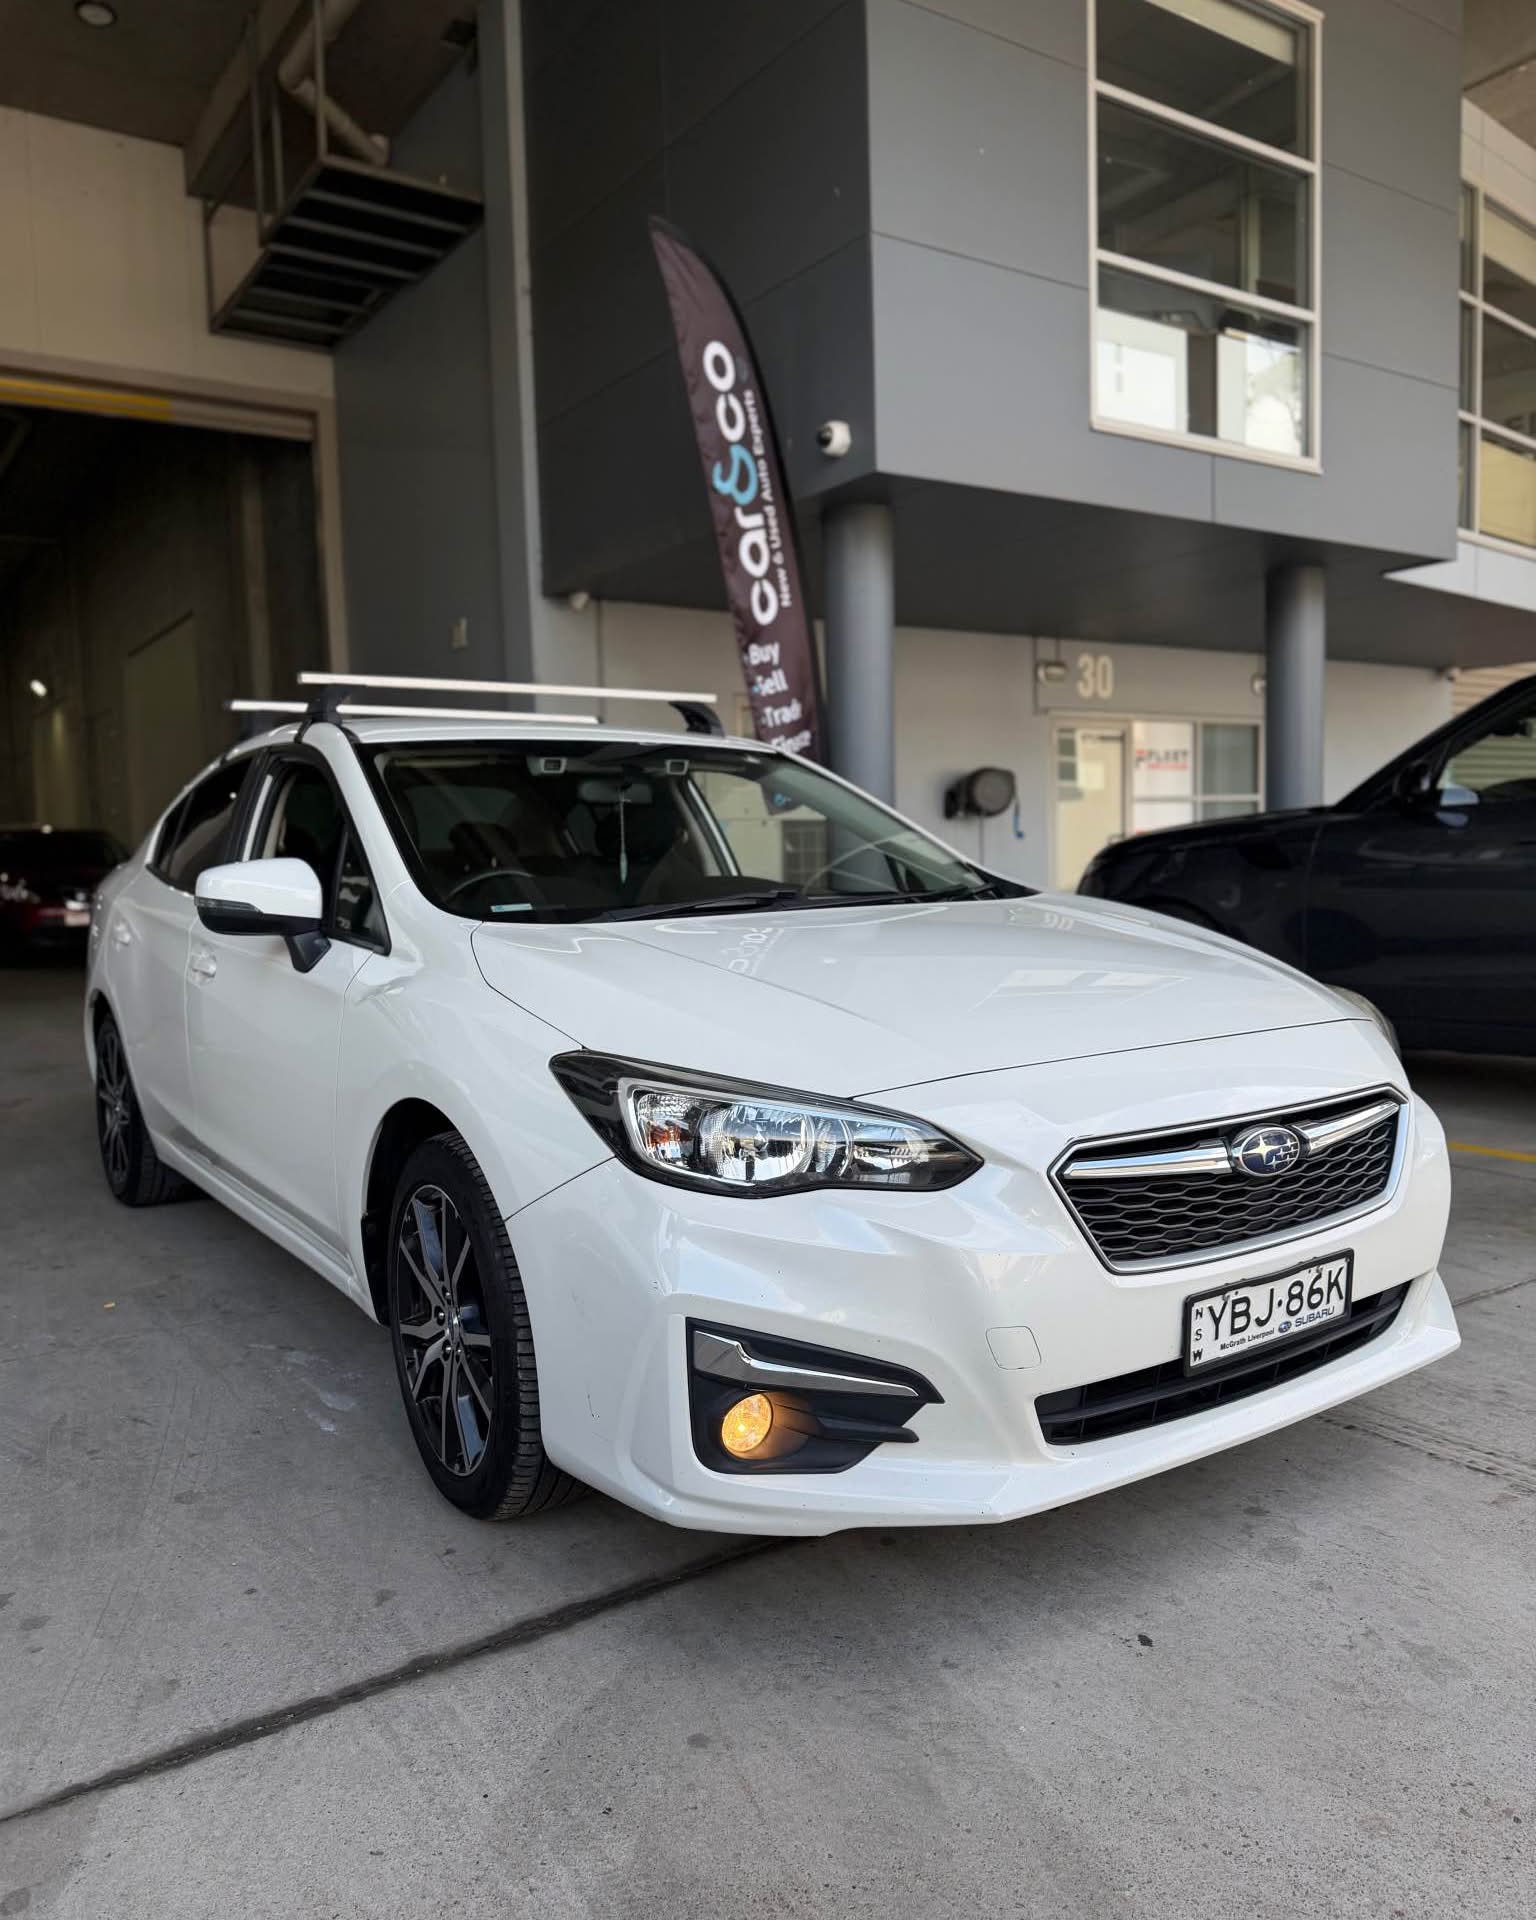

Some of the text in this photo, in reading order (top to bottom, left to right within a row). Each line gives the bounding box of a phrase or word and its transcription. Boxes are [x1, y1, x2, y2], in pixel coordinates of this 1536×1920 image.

[743, 389, 765, 456] Experts
[757, 459, 774, 502] Auto
[763, 505, 782, 549] Used
[776, 567, 792, 608] New
[748, 642, 780, 666] Buy
[1077, 653, 1114, 698] 30
[1220, 1305, 1335, 1350] McGrath Liverpool SUBARU
